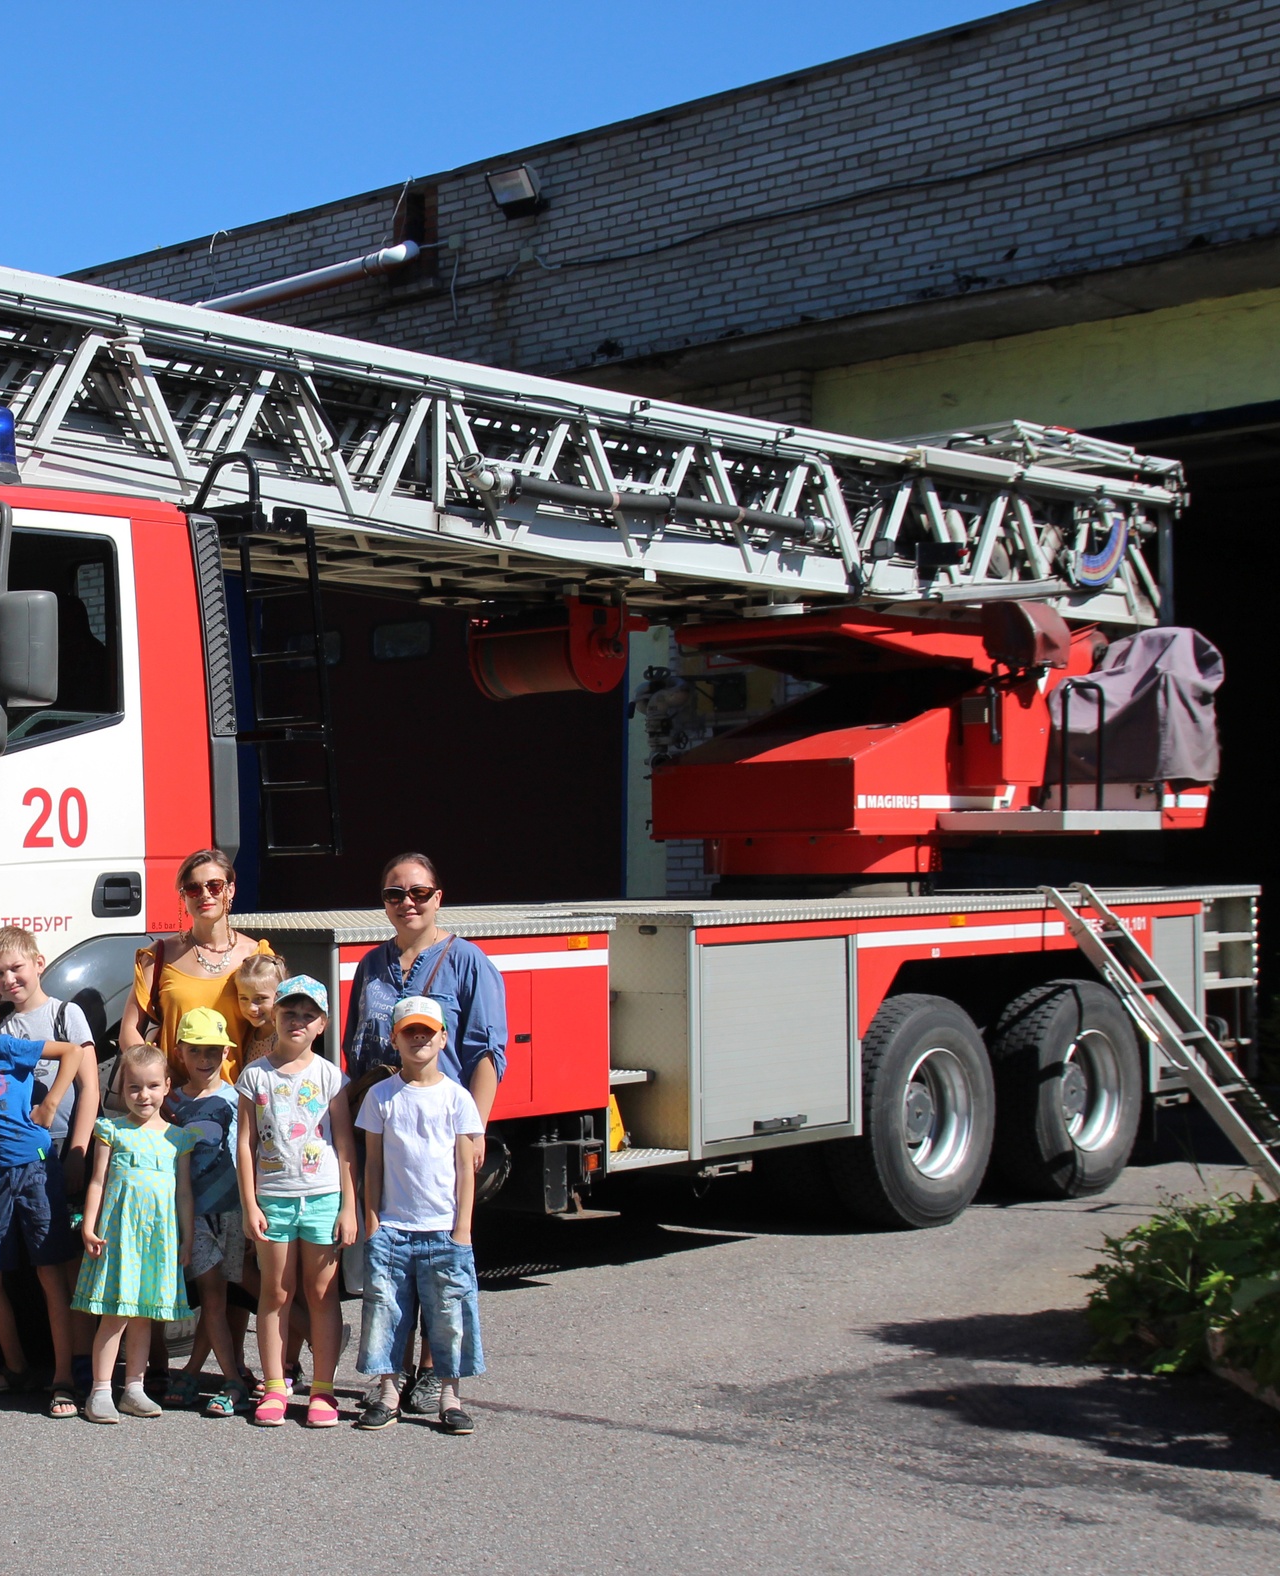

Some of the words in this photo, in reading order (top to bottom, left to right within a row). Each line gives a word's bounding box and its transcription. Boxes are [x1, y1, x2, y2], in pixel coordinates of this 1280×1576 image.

[867, 795, 918, 809] MAGIRUS
[22, 787, 88, 848] 20
[164, 922, 176, 930] bar
